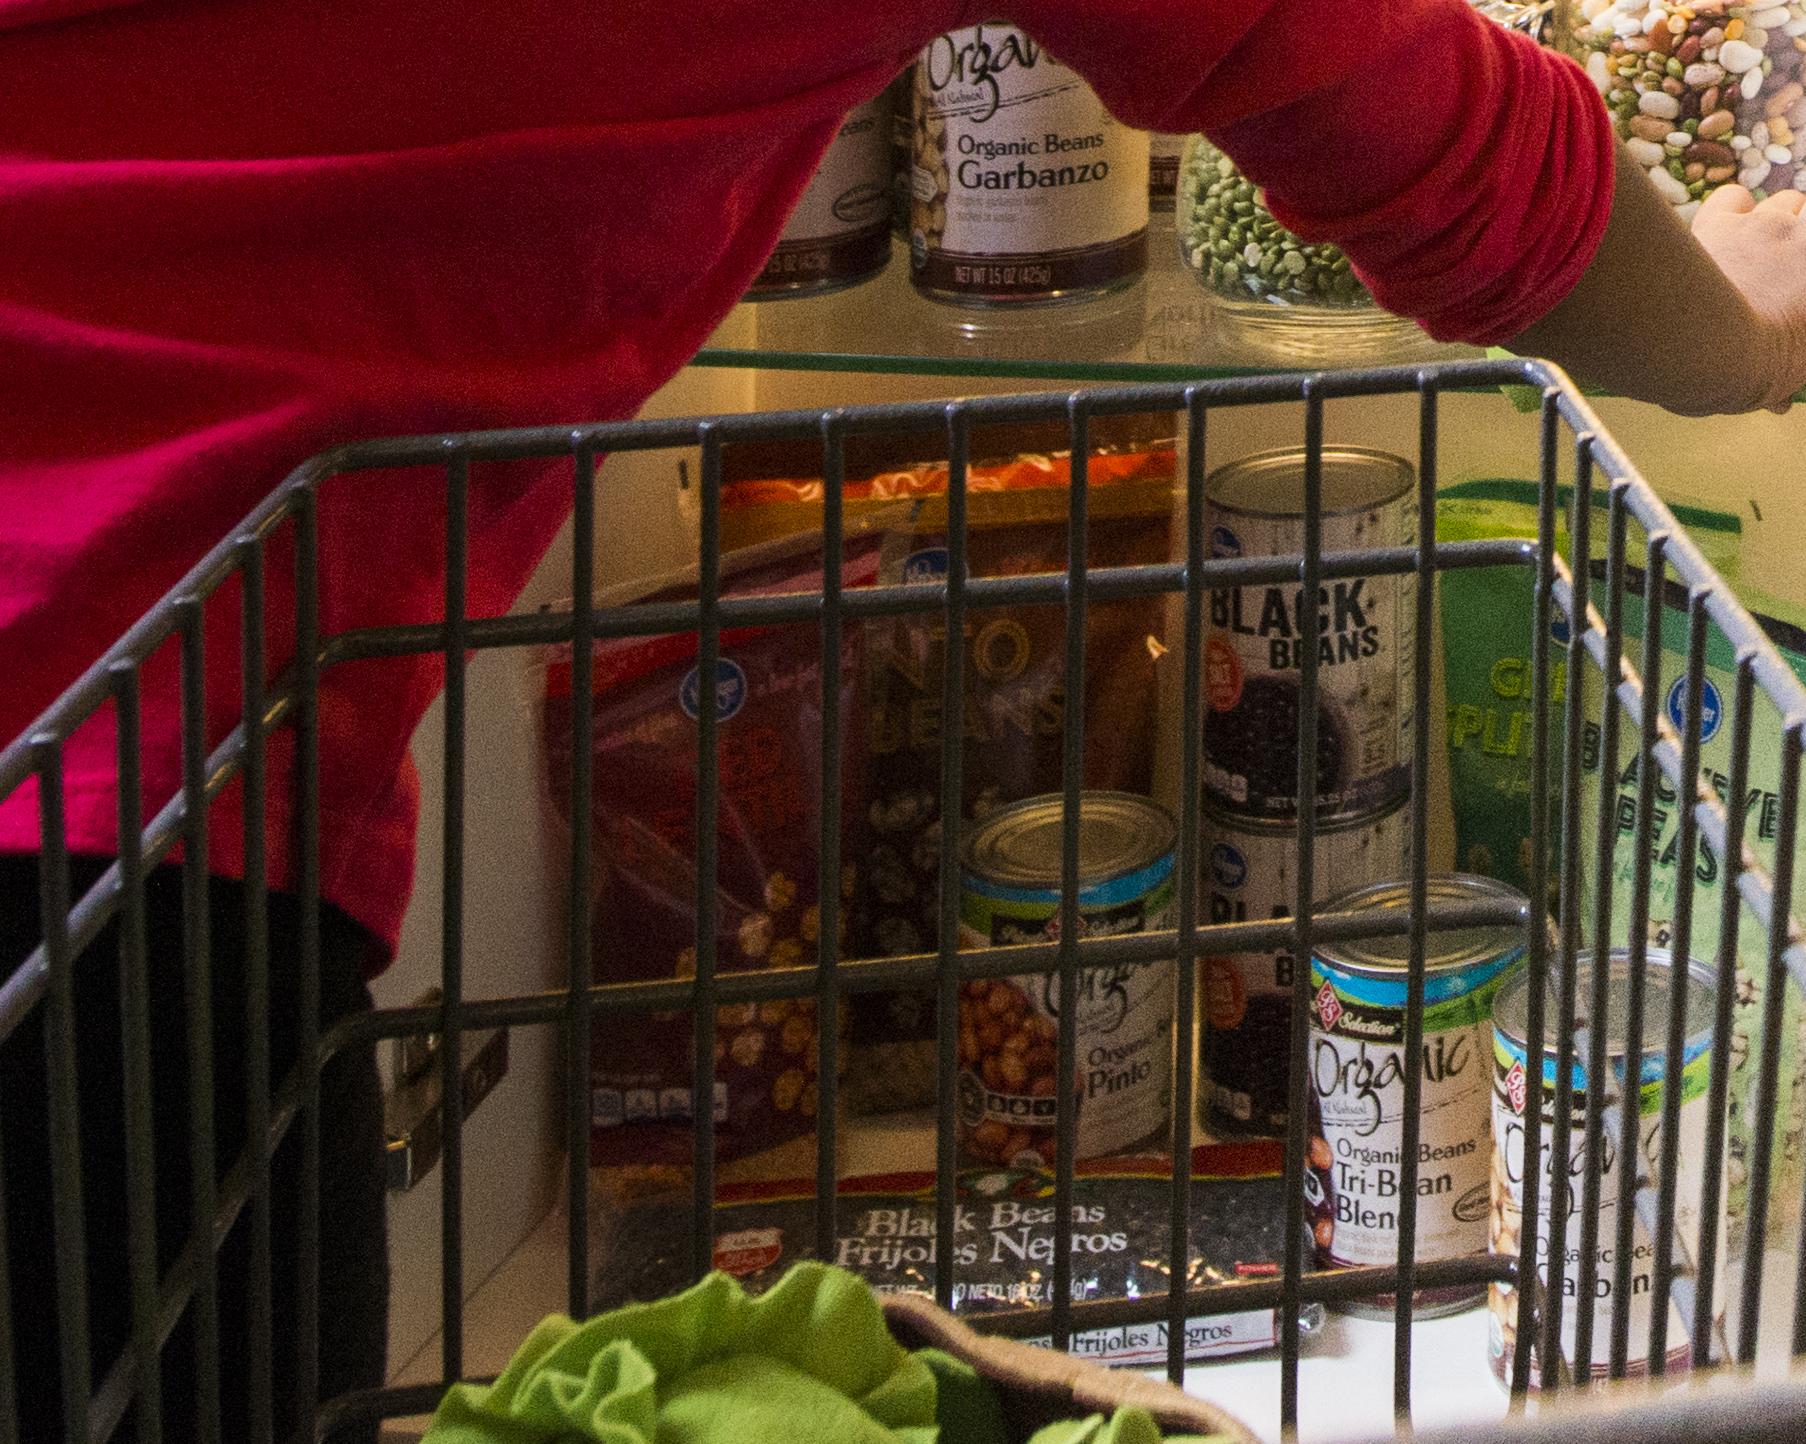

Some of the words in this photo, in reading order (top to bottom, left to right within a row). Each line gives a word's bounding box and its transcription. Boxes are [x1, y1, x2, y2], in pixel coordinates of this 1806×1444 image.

[957, 133, 1041, 161] Organic
[1044, 132, 1105, 155] Beans
[957, 159, 1110, 190] Garbanzo
[954, 266, 972, 285] NET
[972, 266, 988, 284] WT
[1337, 1010, 1403, 1037] Selection
[1417, 1137, 1478, 1164] Beans
[1069, 1328, 1150, 1358] Frijoles
